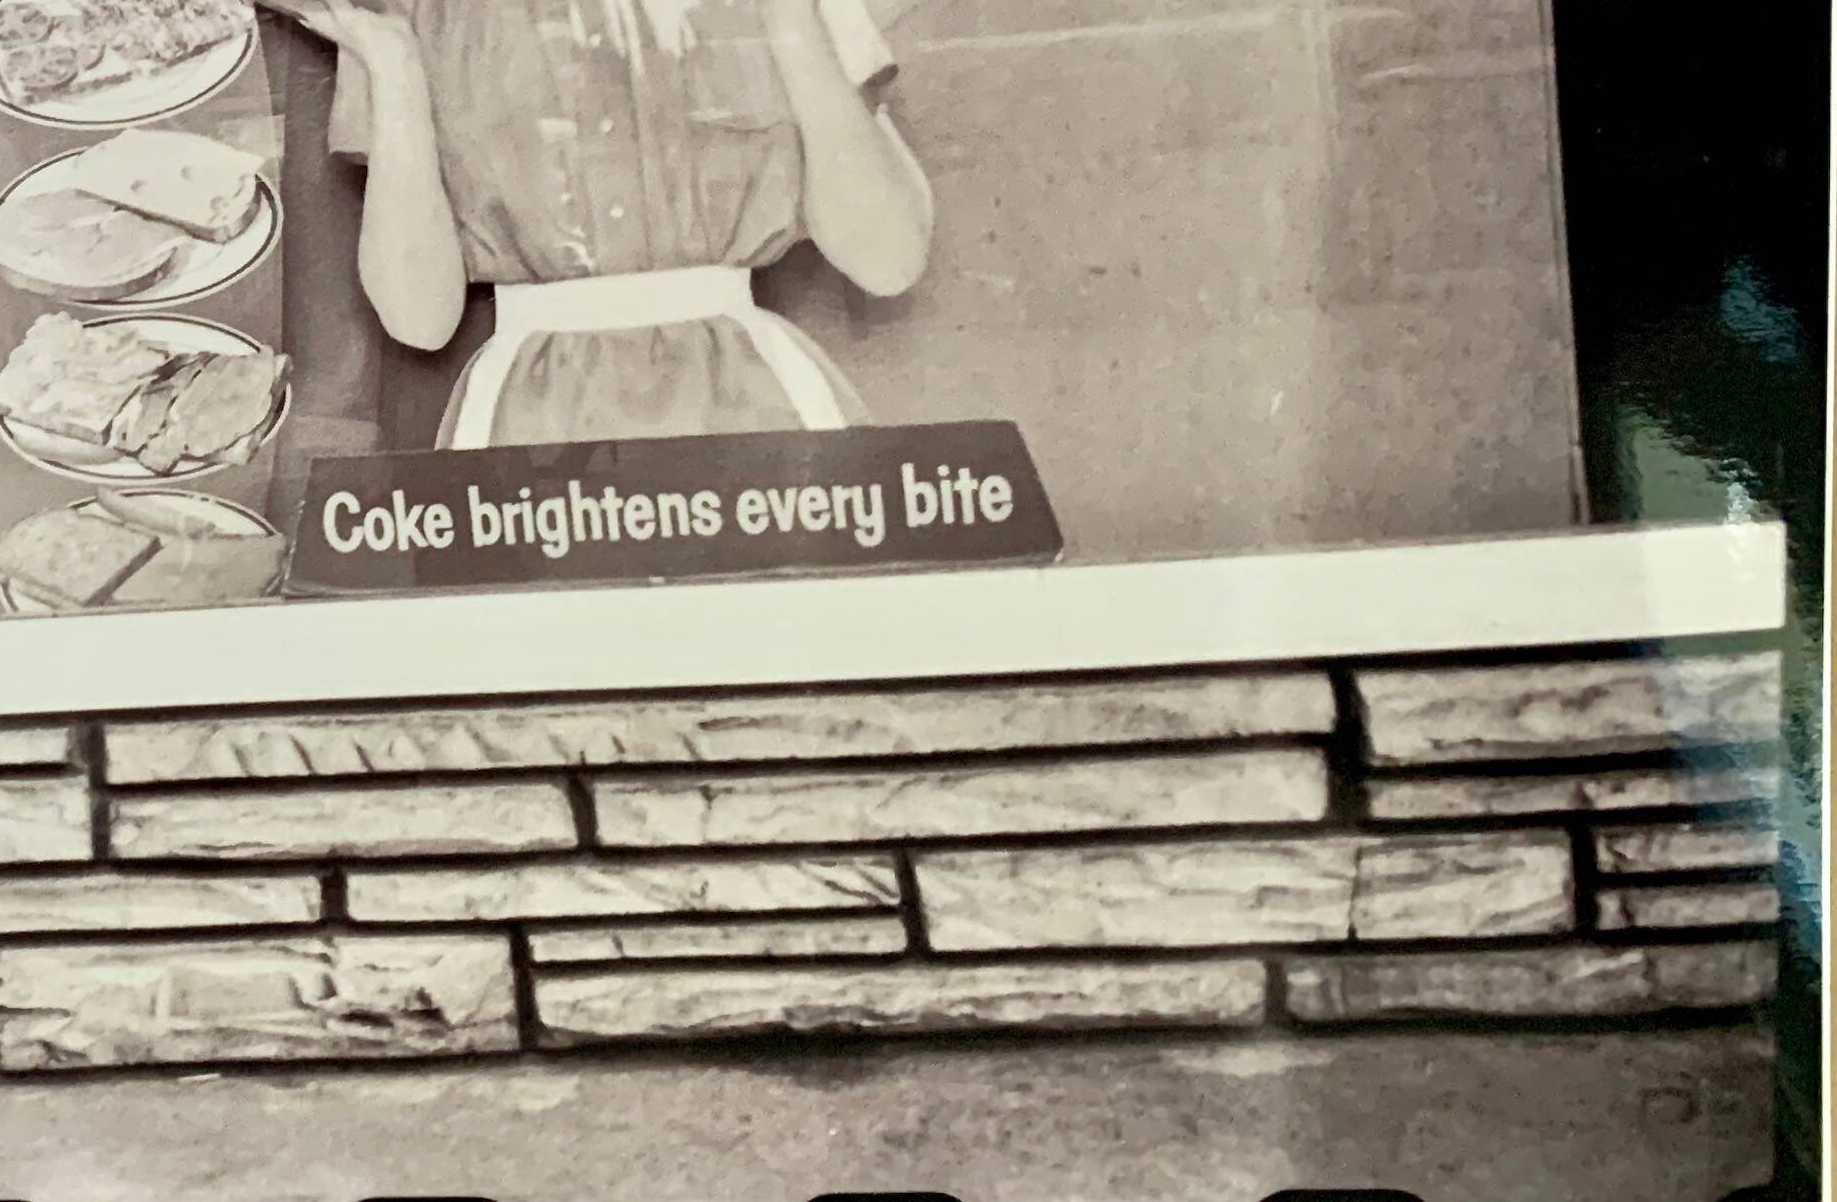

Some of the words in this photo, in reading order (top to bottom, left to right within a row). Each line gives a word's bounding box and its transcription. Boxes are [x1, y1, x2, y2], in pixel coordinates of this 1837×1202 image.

[322, 489, 456, 555] Coke
[467, 479, 724, 559] brightens
[735, 480, 885, 548] every
[899, 462, 1015, 530] bite
